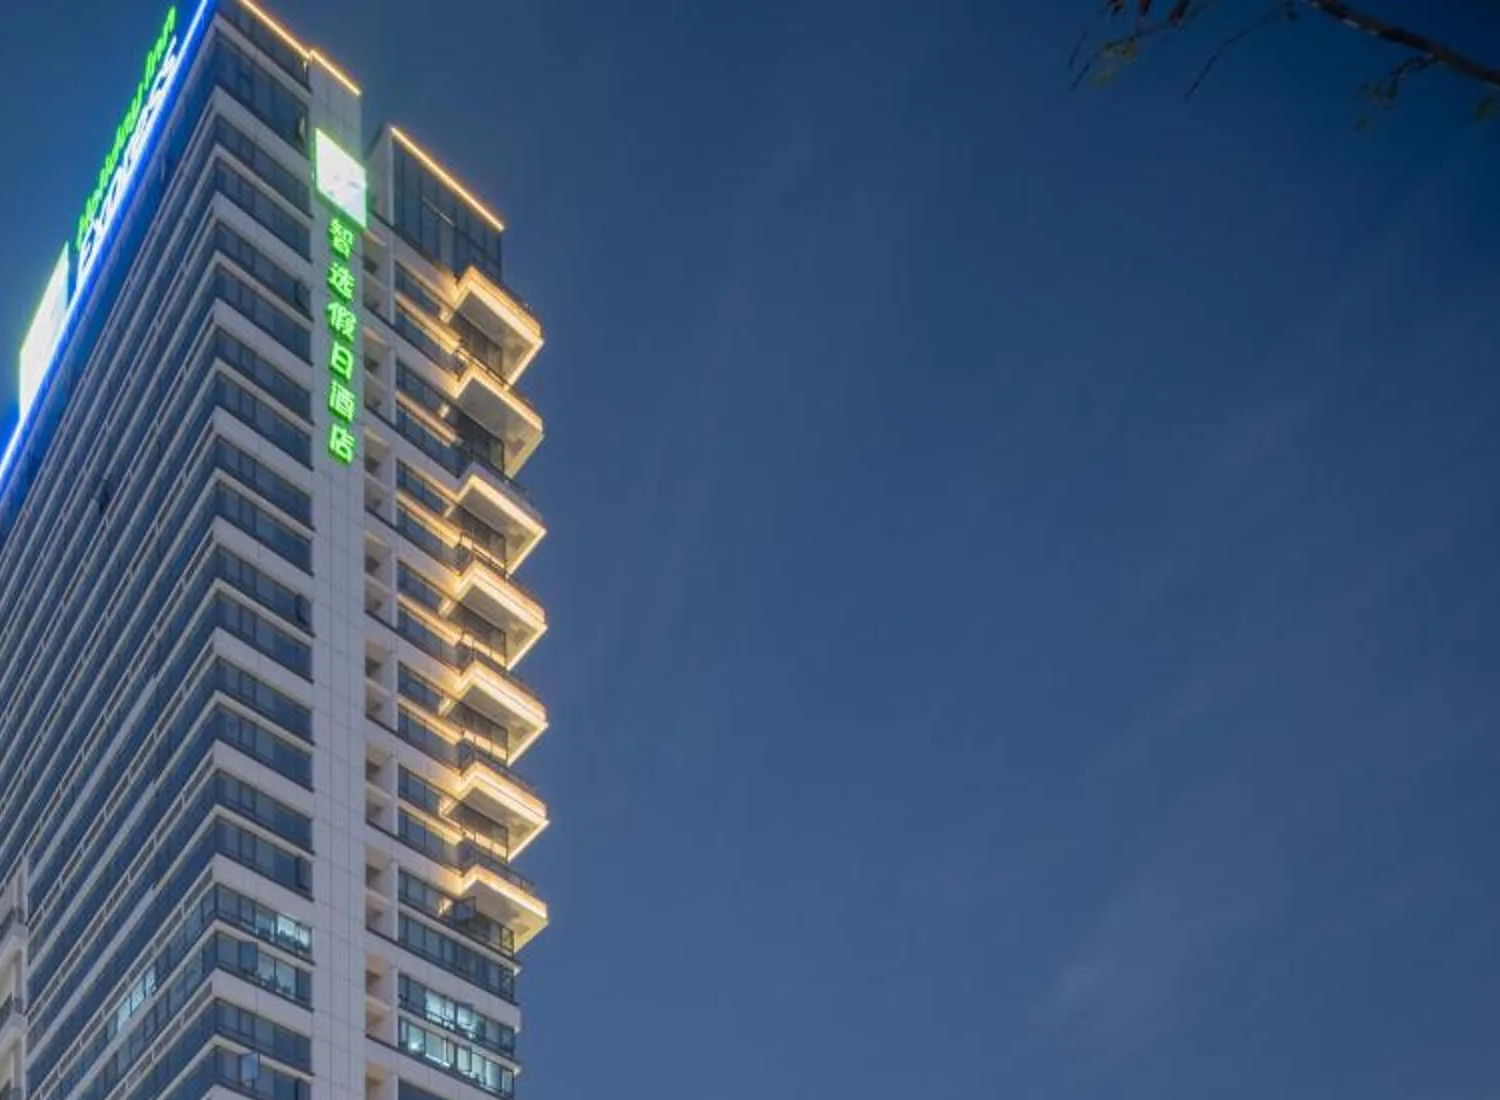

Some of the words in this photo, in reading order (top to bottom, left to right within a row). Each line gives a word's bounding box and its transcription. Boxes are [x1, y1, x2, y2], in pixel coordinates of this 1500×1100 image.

[325, 217, 357, 464] 智选假日酒店
